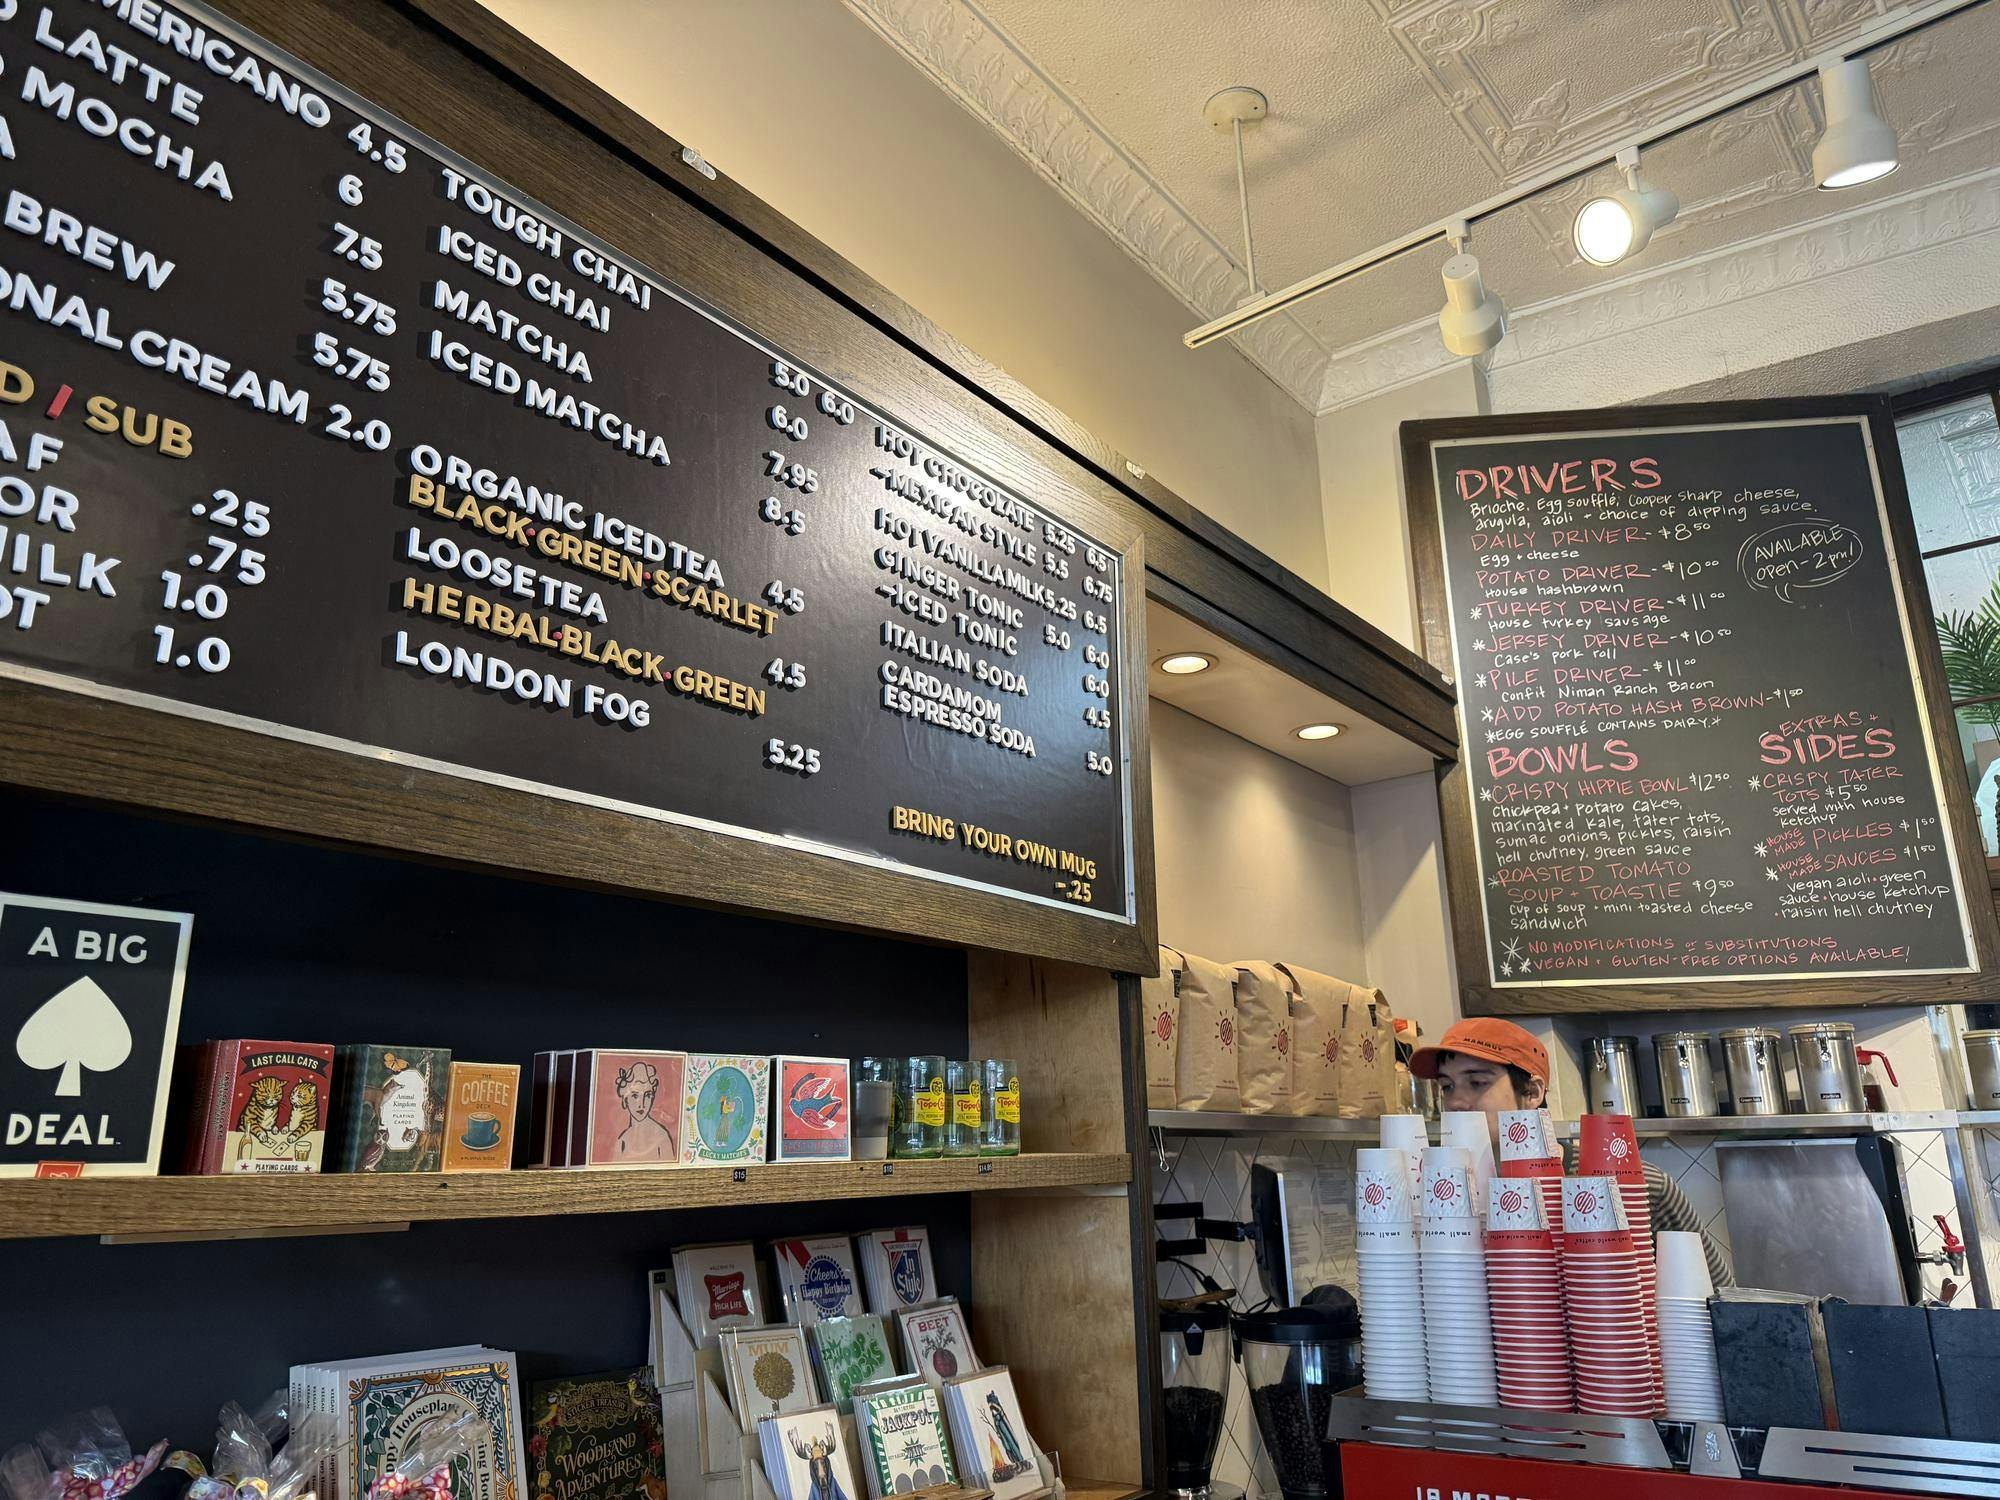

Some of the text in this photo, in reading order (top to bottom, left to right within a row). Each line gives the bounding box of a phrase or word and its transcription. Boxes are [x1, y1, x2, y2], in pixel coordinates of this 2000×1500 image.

[35, 7, 363, 207] LATTE 6
[347, 122, 407, 173] 4.5
[21, 65, 233, 202] MOCHA
[333, 221, 383, 270] 7.5
[4, 190, 391, 393] BREW 5.75
[442, 167, 810, 397] TOUGH CHAI 5.0
[321, 277, 397, 336] 5.75
[439, 224, 808, 441] ICED CHAI 6.0
[434, 279, 819, 494] MATCHA 7.95
[84, 395, 193, 459] SUB
[325, 403, 392, 451] 2.0
[430, 329, 807, 535] ICED MATCHA 8.5
[1456, 457, 1663, 501] DRIVERS
[1677, 488, 1723, 506] sharp
[191, 489, 270, 537] .25
[923, 456, 1107, 573] CHOCOLATE 5.25 6.5
[1599, 502, 1748, 522] choice of dipping
[410, 444, 806, 614] ORGANIC ICED TEA 4.5
[1471, 531, 1537, 552] DAILY
[1526, 549, 1580, 561] cheese
[1755, 524, 1844, 563] AVAILABLE
[188, 535, 266, 585] .75
[981, 521, 1114, 604] STYLE 5.5 6.75
[1475, 568, 1551, 589] POTATO
[1536, 582, 1625, 597] hashbrown
[161, 569, 228, 620] 1.0
[407, 526, 808, 690] LOOSE TEA 4.5
[876, 545, 1110, 670] GINGER TONIC 5.0 6.0
[1045, 587, 1108, 634] 5.25 6.5
[1542, 617, 1592, 630] turkey
[154, 624, 231, 673] 1.0
[956, 610, 1110, 699] TONIC 6.0
[1551, 647, 1617, 665] pork roll
[880, 620, 1111, 730] ITALIAN SODA 4.5
[1558, 679, 1715, 699] Niman Ranch Bacon
[395, 630, 821, 775] LONDON FOG 5.25
[1554, 699, 1684, 718] POTATO HASH
[879, 660, 1113, 776] CARDAMOM 5.0
[880, 683, 1037, 759] ESPRESSO SODA
[1597, 719, 1657, 732] CONTAINS
[1779, 711, 1864, 737] EXTRAS
[1758, 727, 1897, 765] SIDES
[1486, 738, 1640, 780] BOWLS
[1577, 776, 1690, 797] HIPPIE BOWL
[1838, 765, 1905, 785] TATER
[1772, 801, 1818, 817] served
[1491, 812, 1680, 835] marinated tater
[893, 805, 1097, 881] BRING YOUR OWN MUG
[1495, 825, 1733, 850] sumac raisin
[1495, 843, 1693, 867] hell green sauce
[1824, 847, 1897, 872] SAUCES
[1605, 860, 1692, 881] TOMATO
[1506, 881, 1683, 903] SOUP TOASTIE
[1787, 878, 1833, 896] vegan
[1509, 900, 1754, 917] cup of soup mini toasted cheese
[1833, 901, 1934, 919] hell chutney
[1510, 914, 1589, 931] sandwich
[27, 926, 148, 964] A BIG
[1528, 936, 1839, 954] NO MODIFICATIONS SUBSTITUTIONS
[1532, 951, 1799, 970] VEGAN OPTIONS
[252, 1054, 319, 1070] LAST CALL CATS
[392, 1101, 417, 1109] Kingdom
[461, 1080, 510, 1107] COFFEE
[917, 1097, 938, 1111] Topo
[957, 1099, 977, 1112] Topo
[255, 1163, 279, 1171] PLAYING
[702, 1150, 748, 1160] LUCKY MATCHES
[810, 1266, 840, 1282] Cheers
[896, 1273, 921, 1299] Style
[712, 1280, 740, 1296] Marriage
[802, 1281, 851, 1301] Happy Birthday
[730, 1300, 742, 1310] LIFE
[918, 1316, 949, 1332] BEET
[747, 1342, 789, 1357] MUM
[567, 1400, 595, 1417] STICKER
[881, 1408, 933, 1435] JACKPOT
[555, 1432, 637, 1477] WOODLAND
